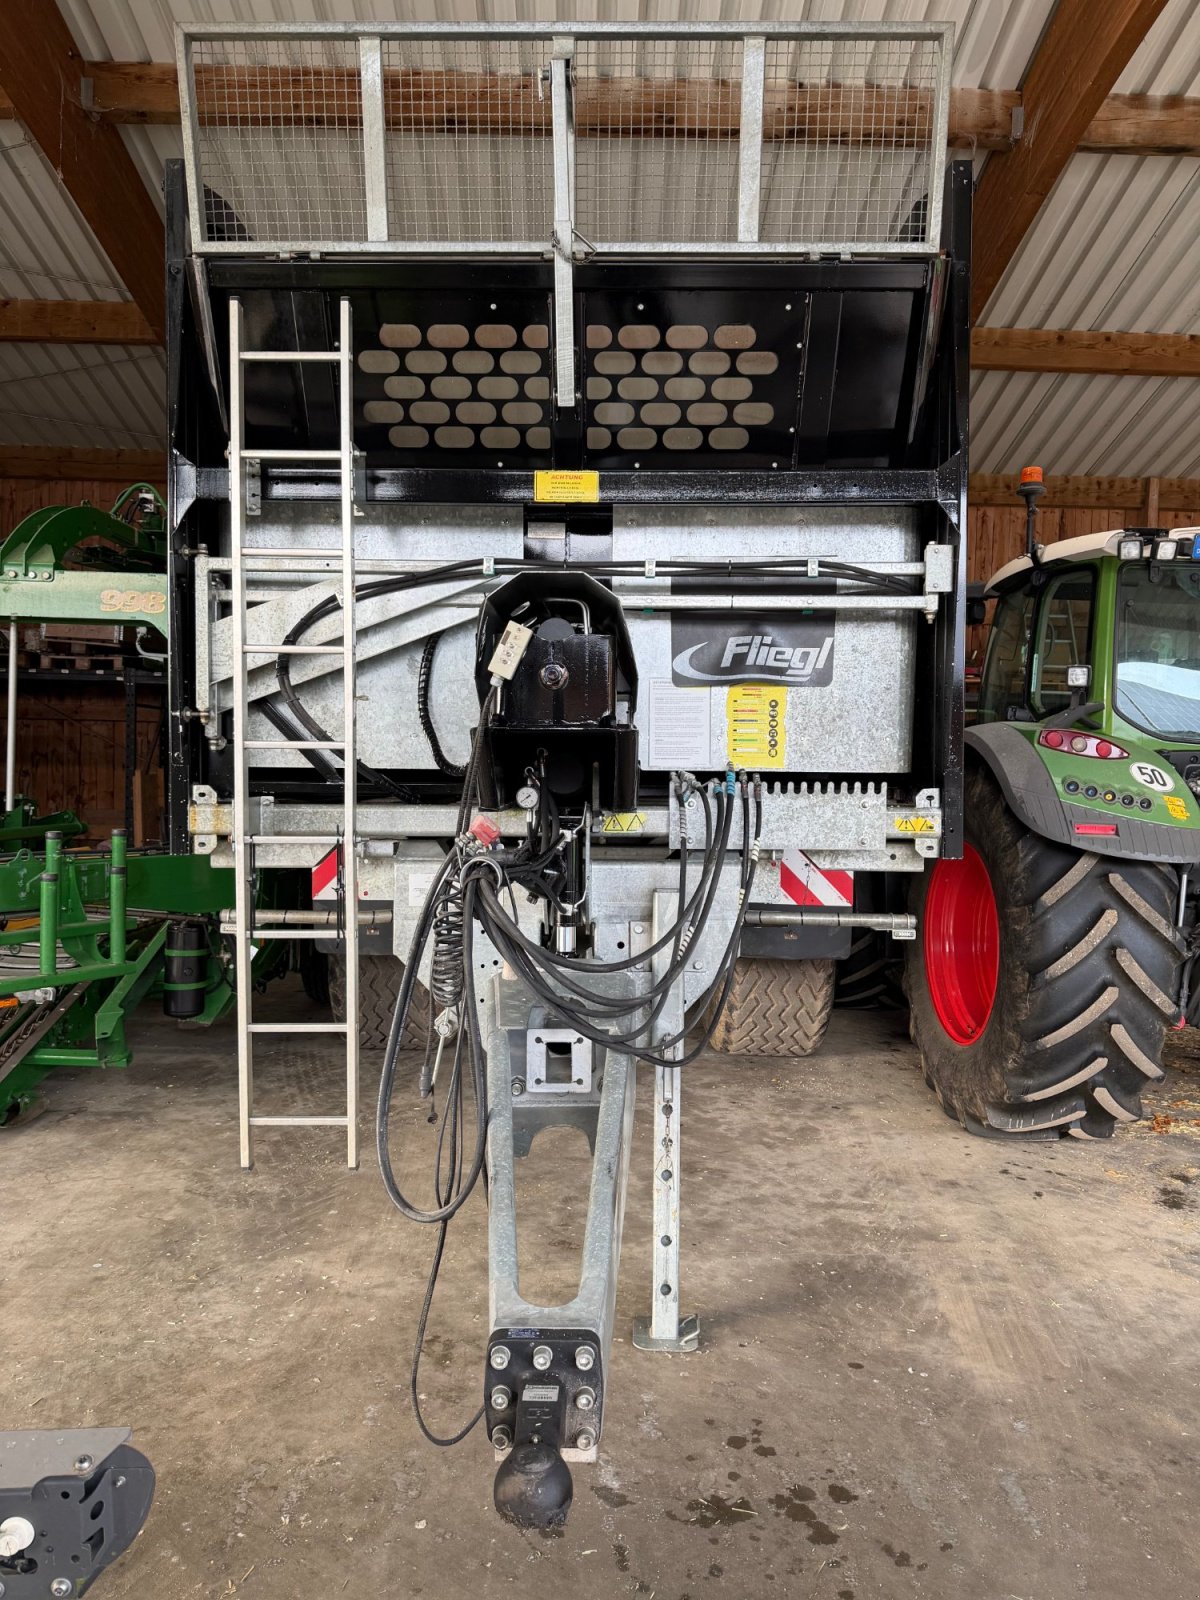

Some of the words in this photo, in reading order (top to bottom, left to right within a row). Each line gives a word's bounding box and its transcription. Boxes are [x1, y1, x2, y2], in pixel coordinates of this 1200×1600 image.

[101, 590, 166, 613] 998
[720, 635, 834, 675] Fliegl
[1137, 766, 1166, 787] 50
